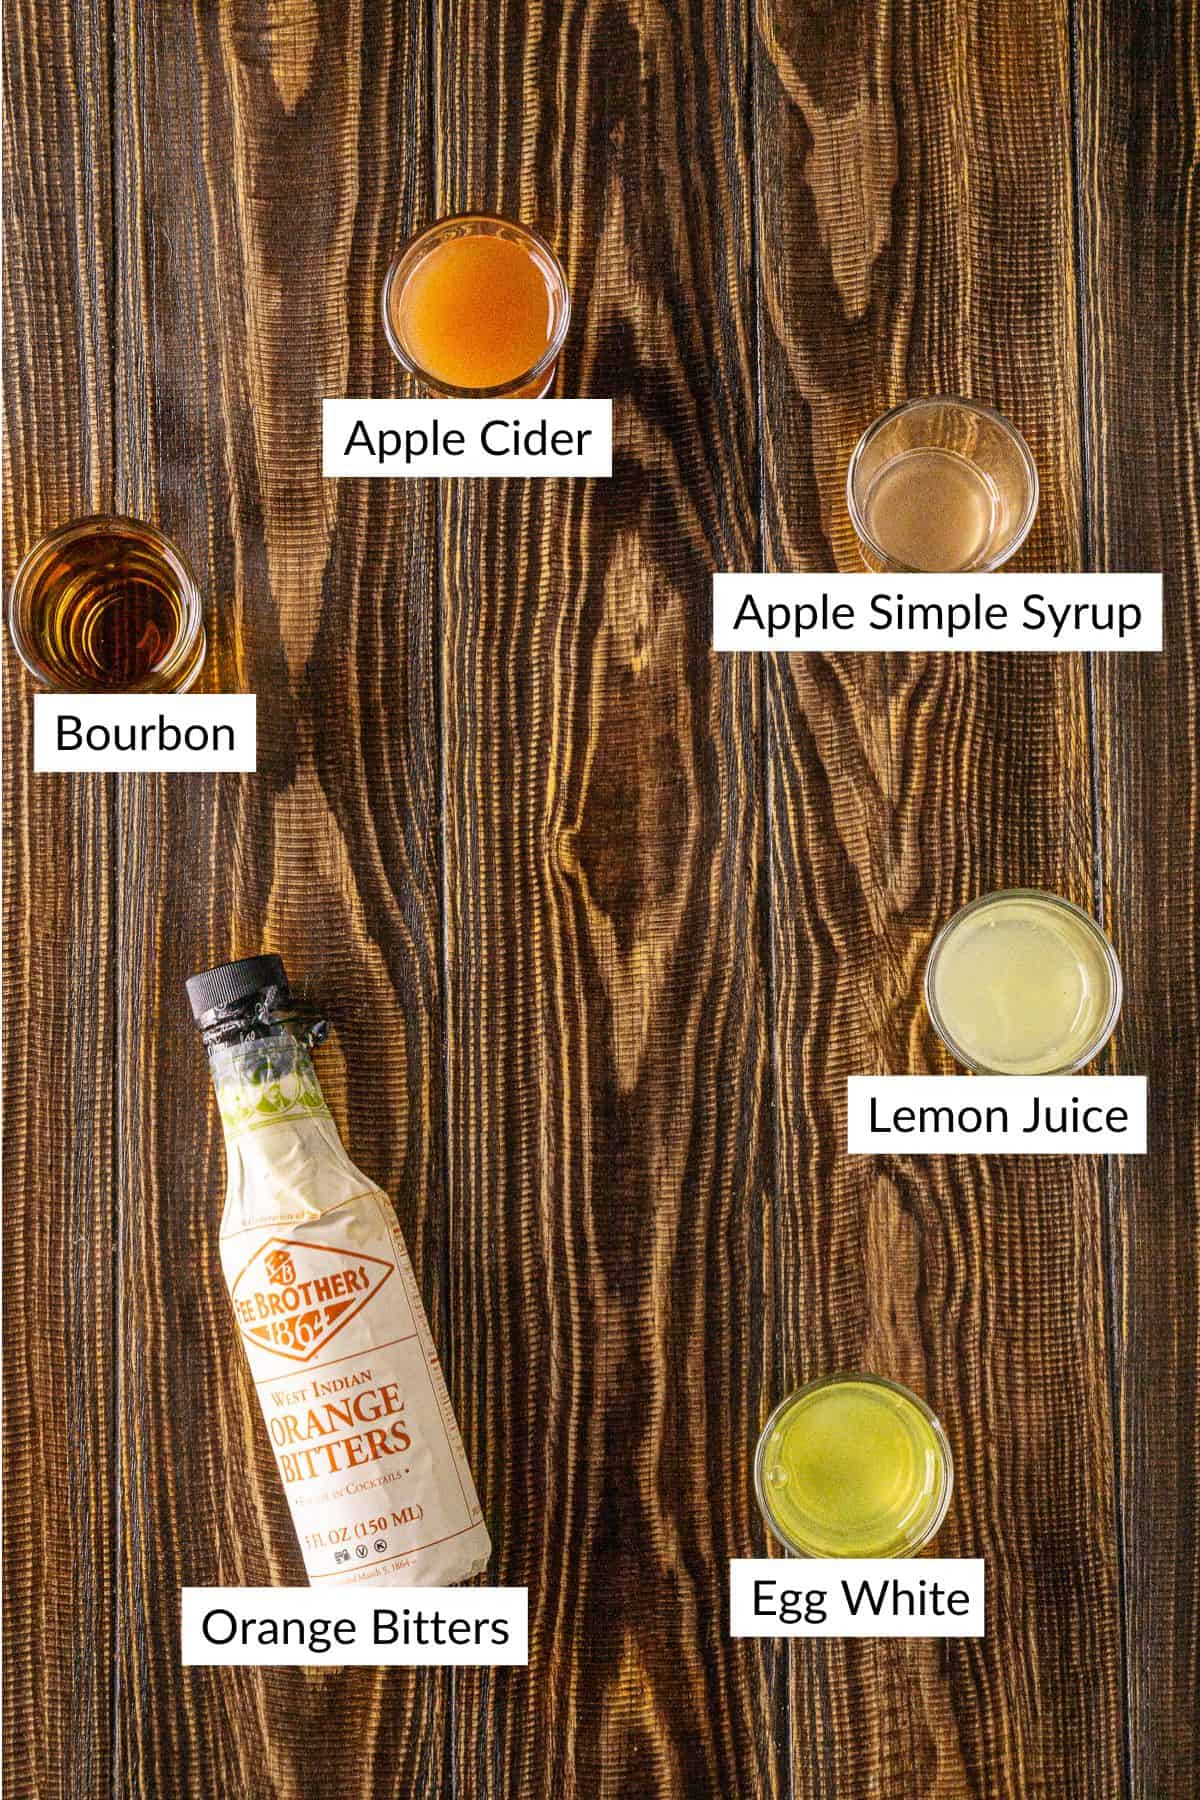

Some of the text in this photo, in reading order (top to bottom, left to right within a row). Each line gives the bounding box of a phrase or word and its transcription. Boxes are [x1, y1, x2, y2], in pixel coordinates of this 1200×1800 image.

[255, 1265, 370, 1320] BROTHERS
[270, 1383, 406, 1447] ORANGE
[271, 1369, 373, 1408] WEST INDIAN
[279, 1420, 412, 1483] BITTERS
[328, 1527, 352, 1545] OZ
[353, 1516, 388, 1539] (150
[391, 1503, 424, 1528] ML)
